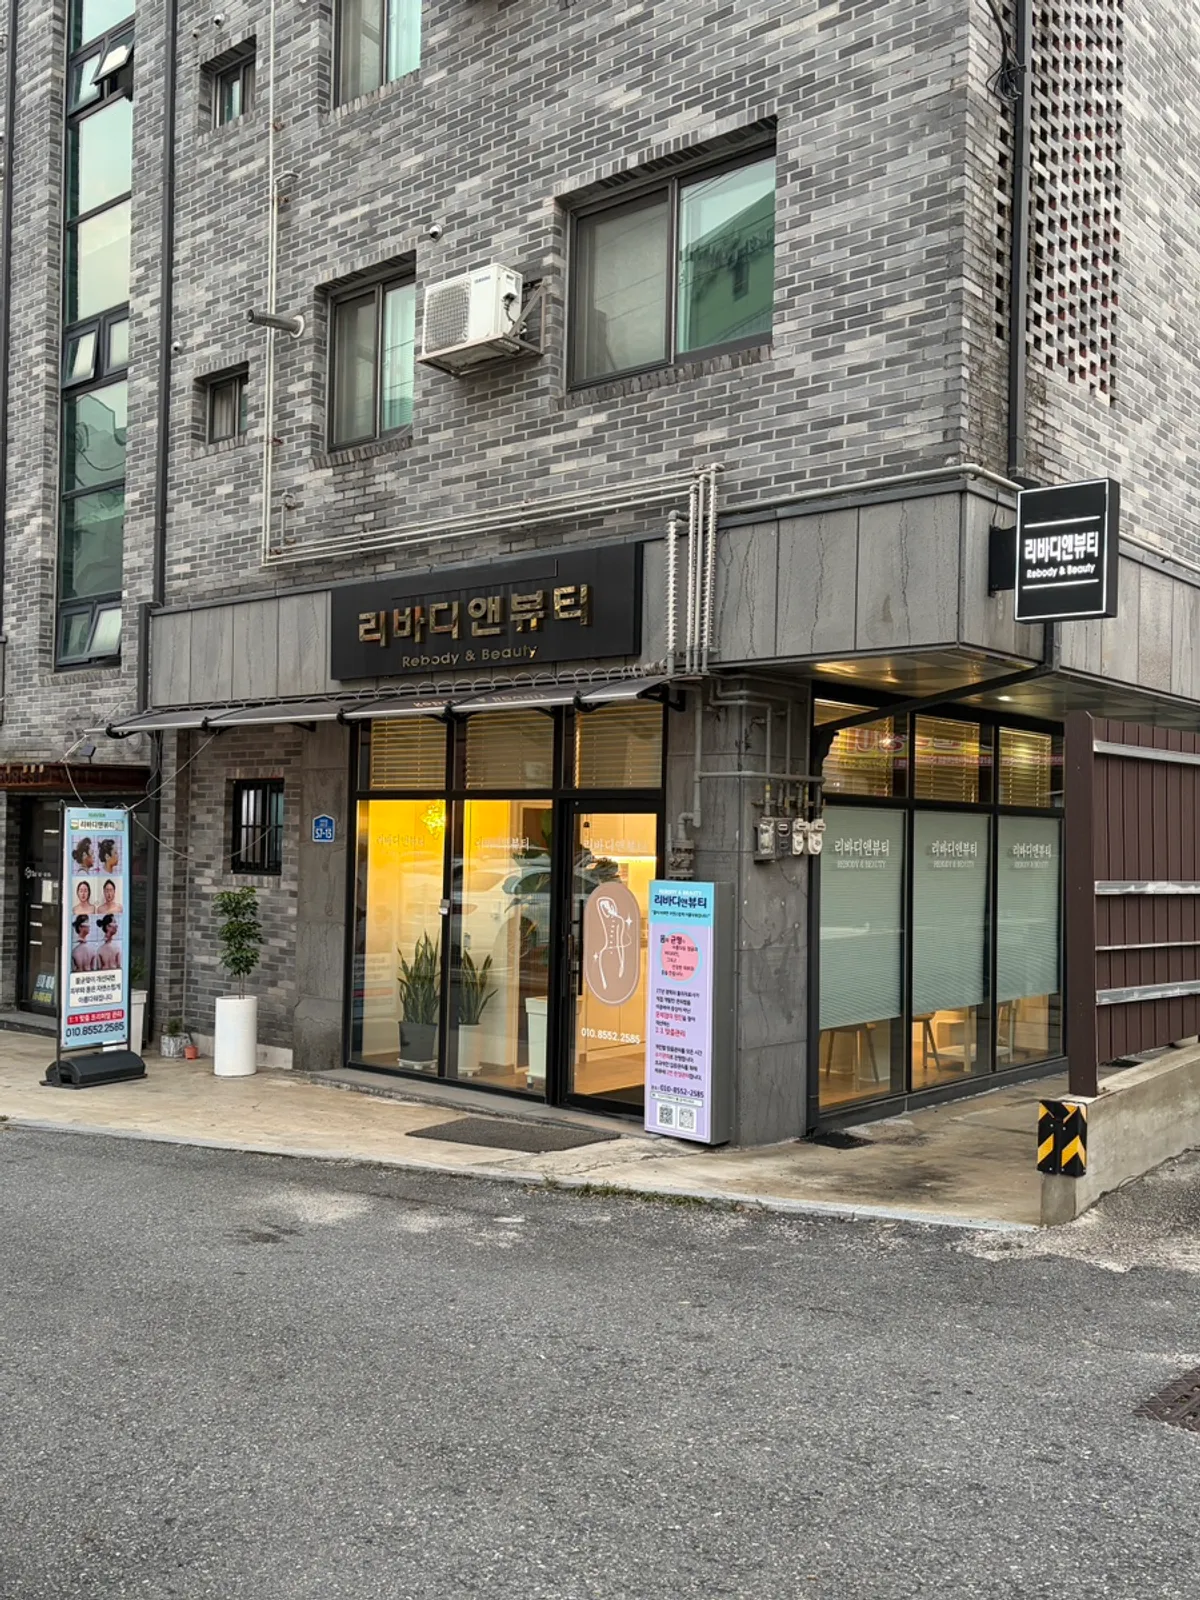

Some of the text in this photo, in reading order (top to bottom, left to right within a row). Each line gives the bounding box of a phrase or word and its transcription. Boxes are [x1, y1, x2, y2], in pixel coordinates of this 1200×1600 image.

[1024, 531, 1099, 564] 리바디앤뷰티
[1026, 563, 1096, 578] Rebody & Beauty
[358, 583, 590, 648] 리바디앤뷰티
[402, 645, 539, 668] Rebody & Beauty
[834, 837, 890, 856] 리바디앤뷰티
[931, 840, 978, 857] 리바디앤뷰티
[1012, 843, 1052, 858] 리바디앤뷰티
[654, 894, 707, 909] 리바디앤뷰티
[65, 1021, 125, 1038] 010.8552.2585
[581, 1027, 641, 1045] 010.8552.2585
[660, 1084, 705, 1098] 010-8552-2585
